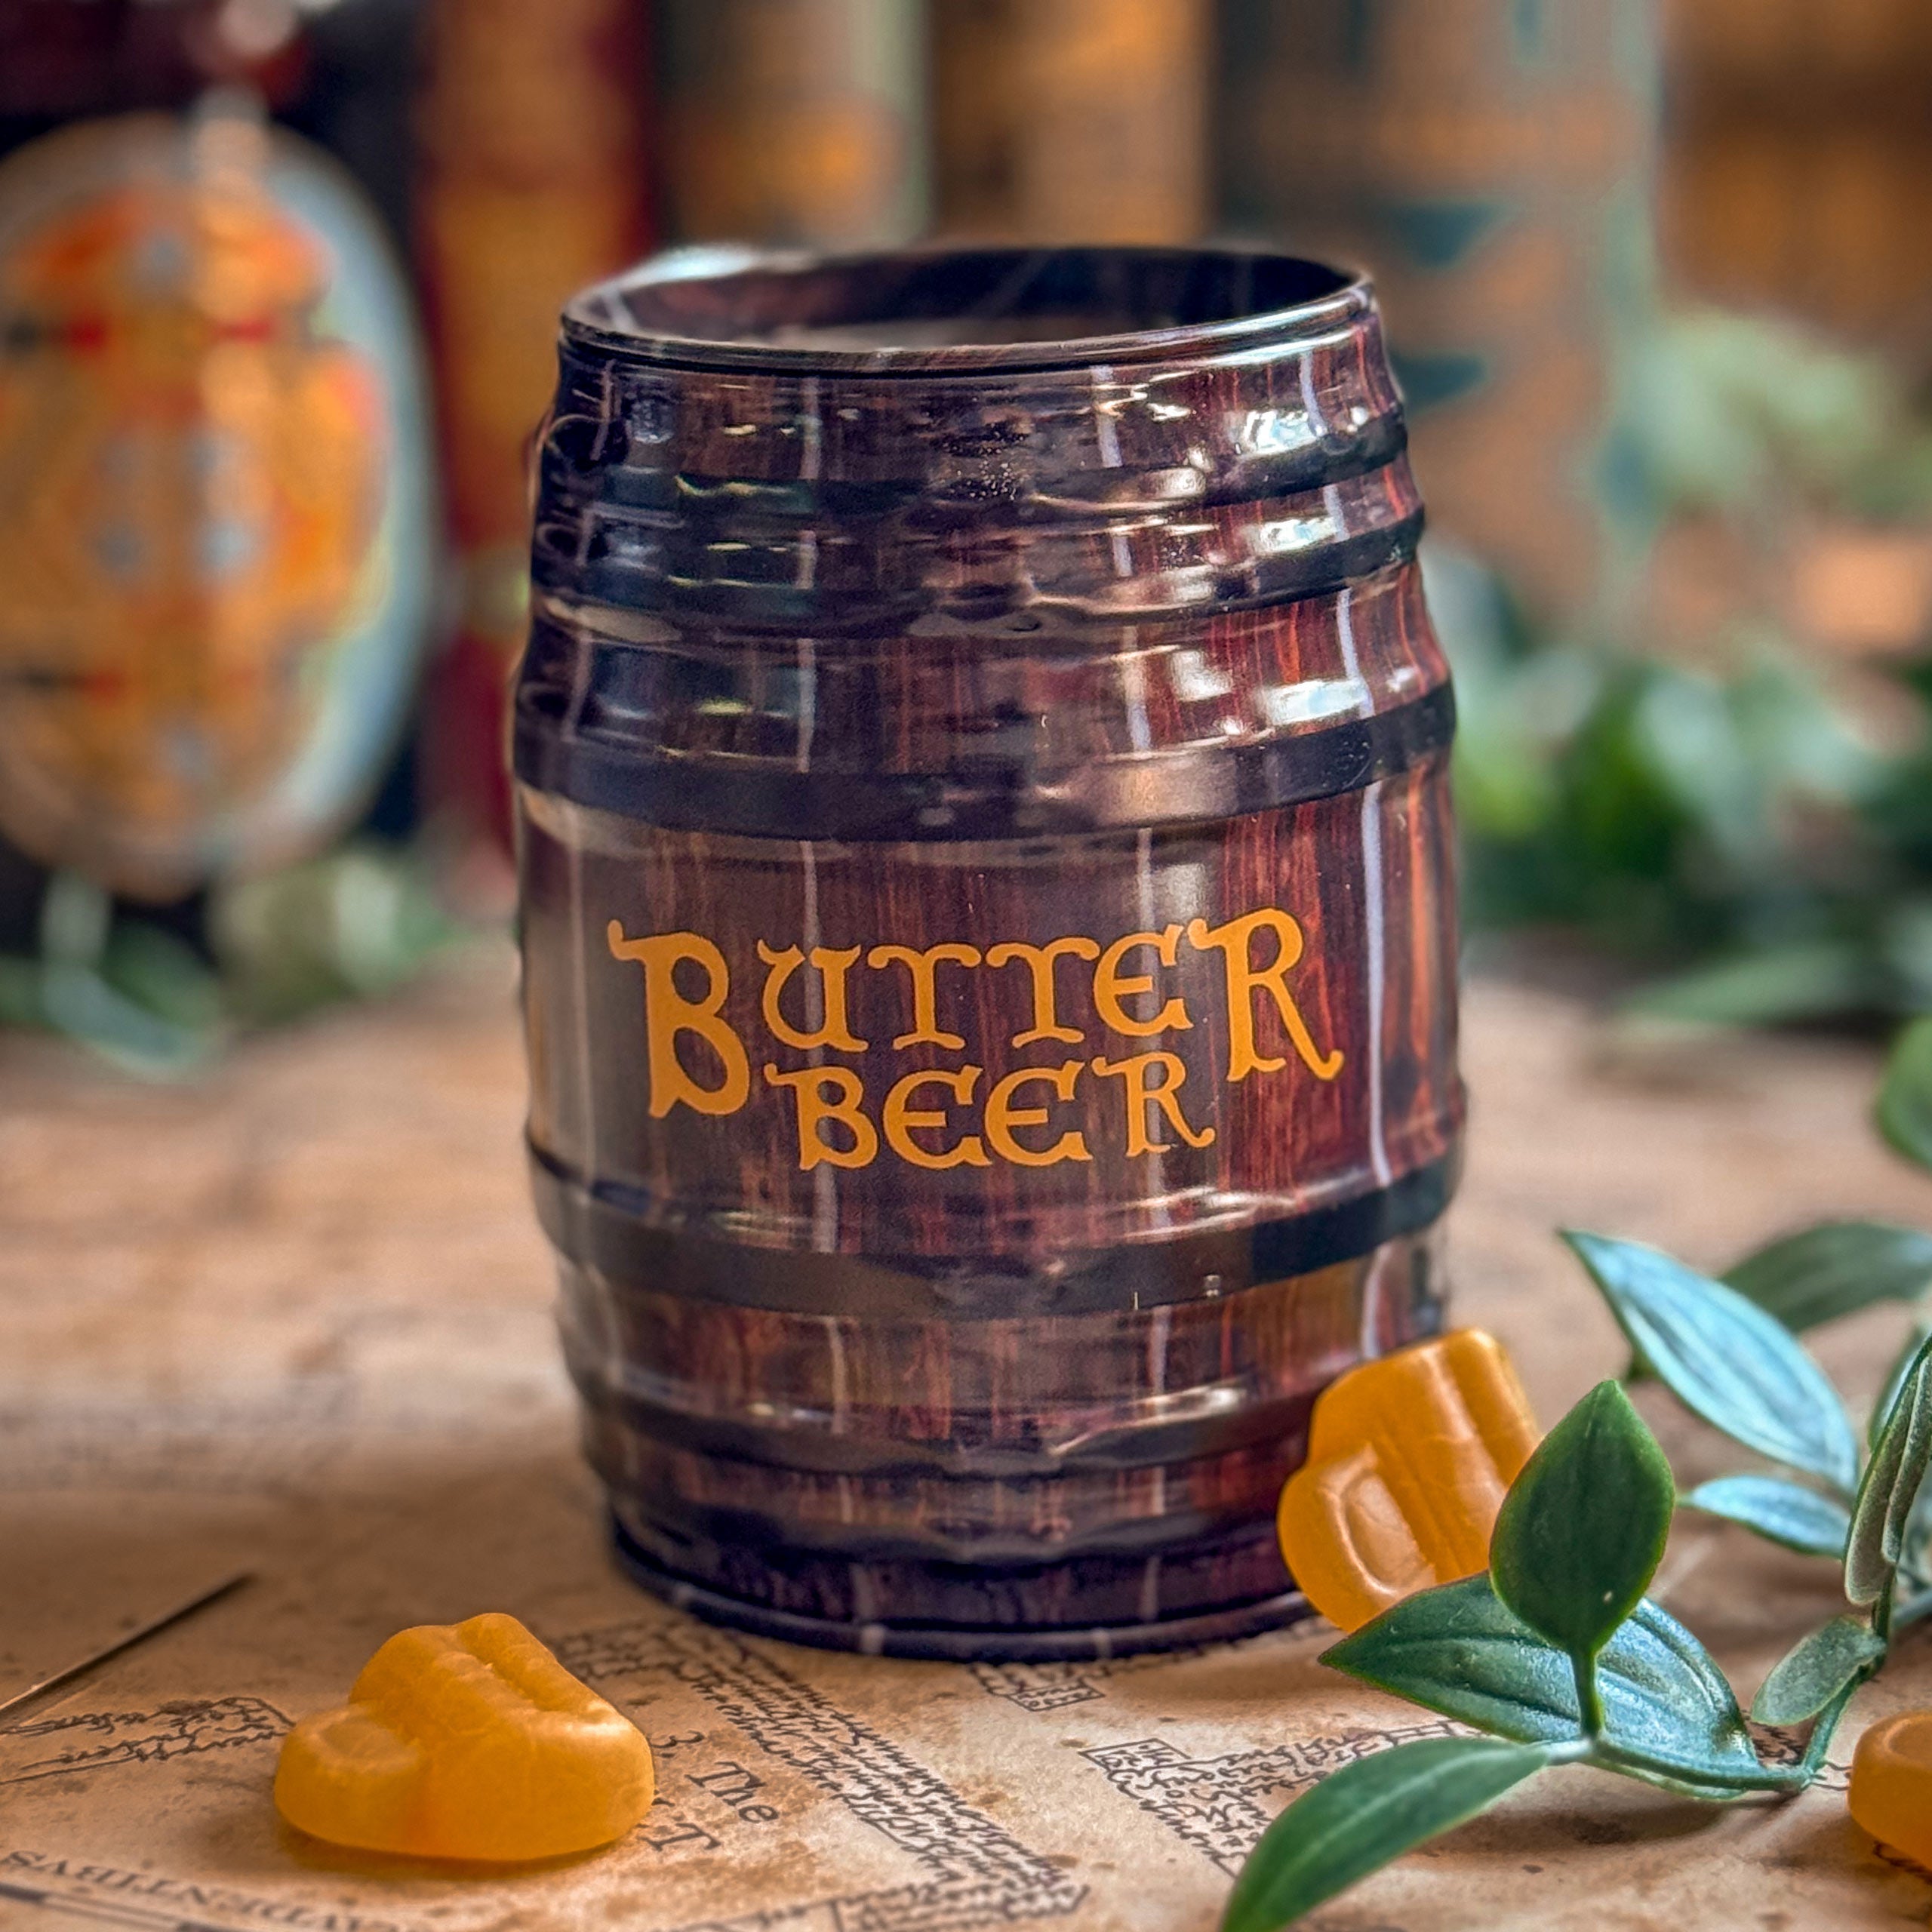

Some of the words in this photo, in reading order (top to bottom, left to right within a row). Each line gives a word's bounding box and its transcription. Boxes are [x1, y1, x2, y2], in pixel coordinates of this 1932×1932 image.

[607, 907, 1345, 1120] BUTTER
[764, 1051, 1217, 1172] BEER
[684, 1761, 780, 1824] The
